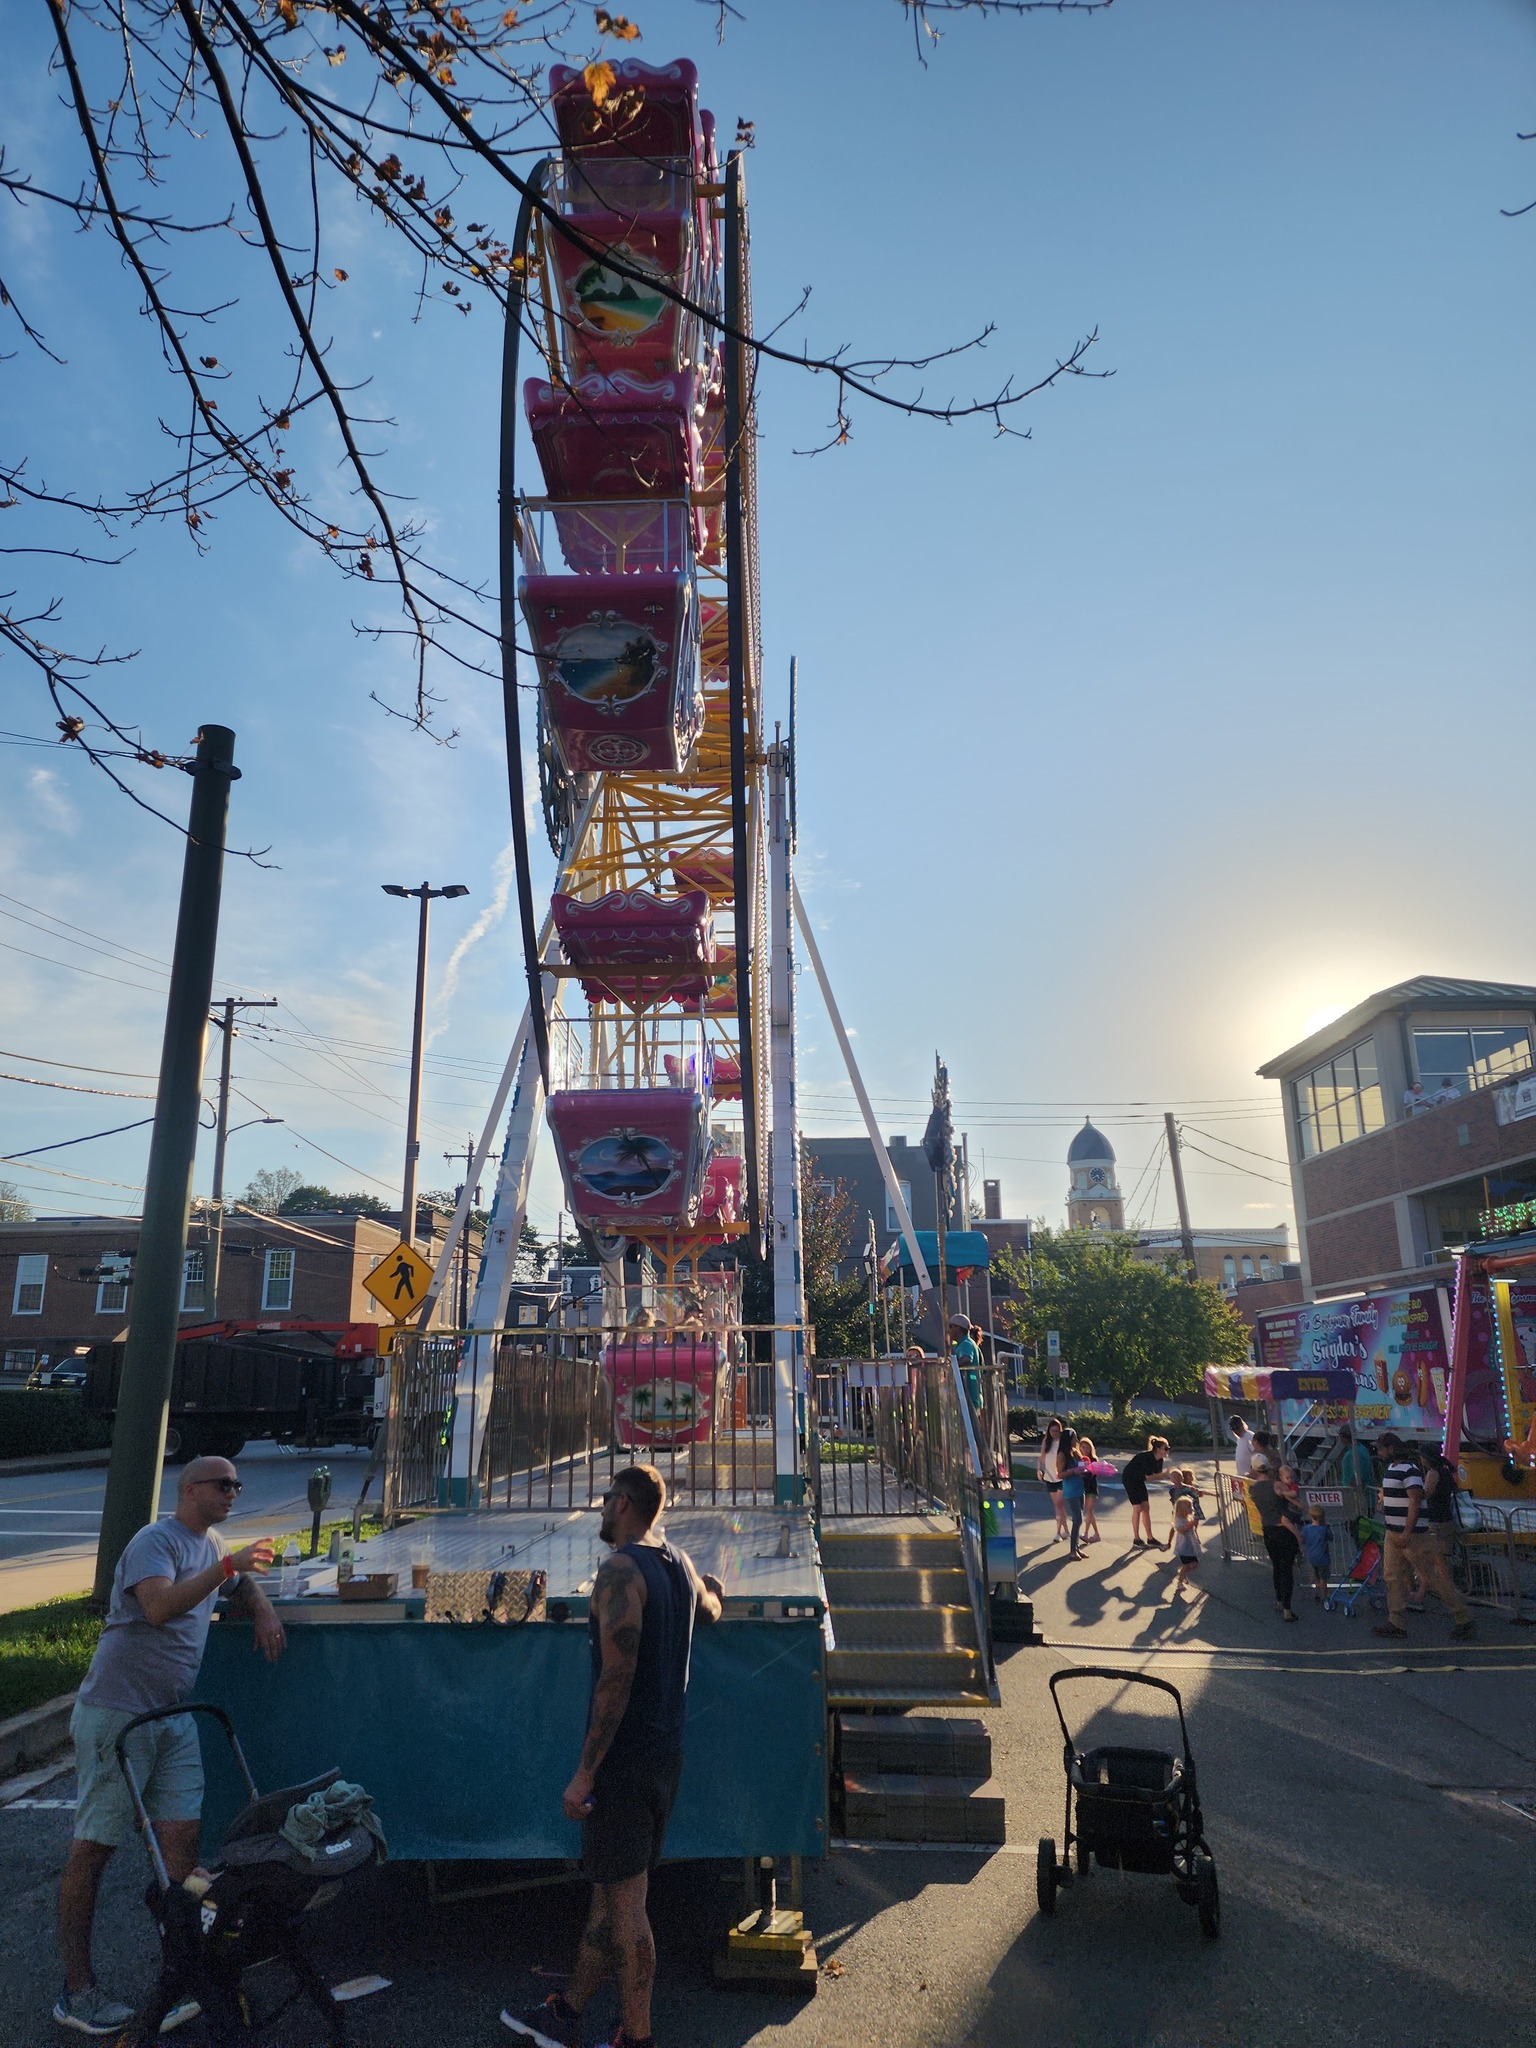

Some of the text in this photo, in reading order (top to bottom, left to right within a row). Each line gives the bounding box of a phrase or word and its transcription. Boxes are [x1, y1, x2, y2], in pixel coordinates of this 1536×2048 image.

[1350, 1302, 1378, 1330] Family
[1312, 1334, 1368, 1368] Snyder's
[1297, 1377, 1329, 1391] ENTER
[1308, 1492, 1340, 1503] ENTER
